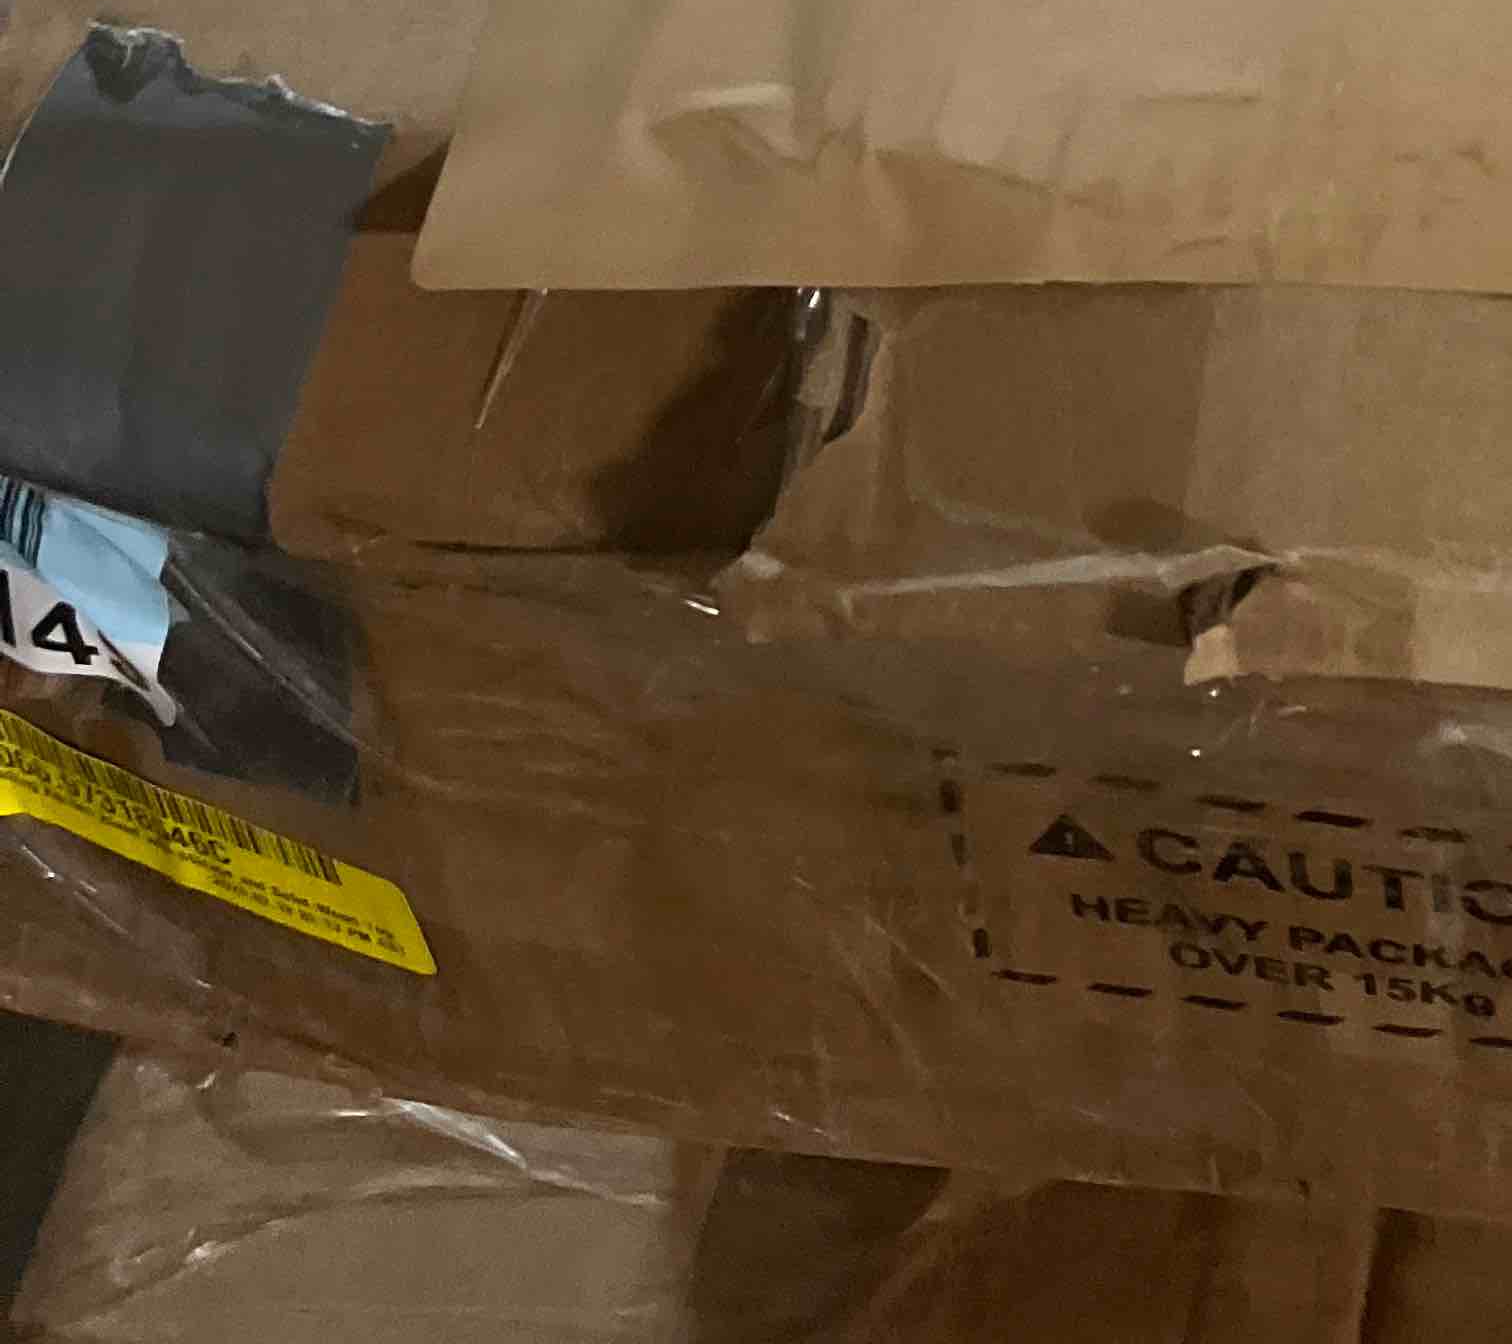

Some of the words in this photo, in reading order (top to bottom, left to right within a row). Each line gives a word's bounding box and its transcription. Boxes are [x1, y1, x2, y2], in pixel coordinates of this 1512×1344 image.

[1070, 893, 1268, 943] HEAVY
[1168, 943, 1335, 993] OVER
[1354, 973, 1497, 1018] 15Kg
